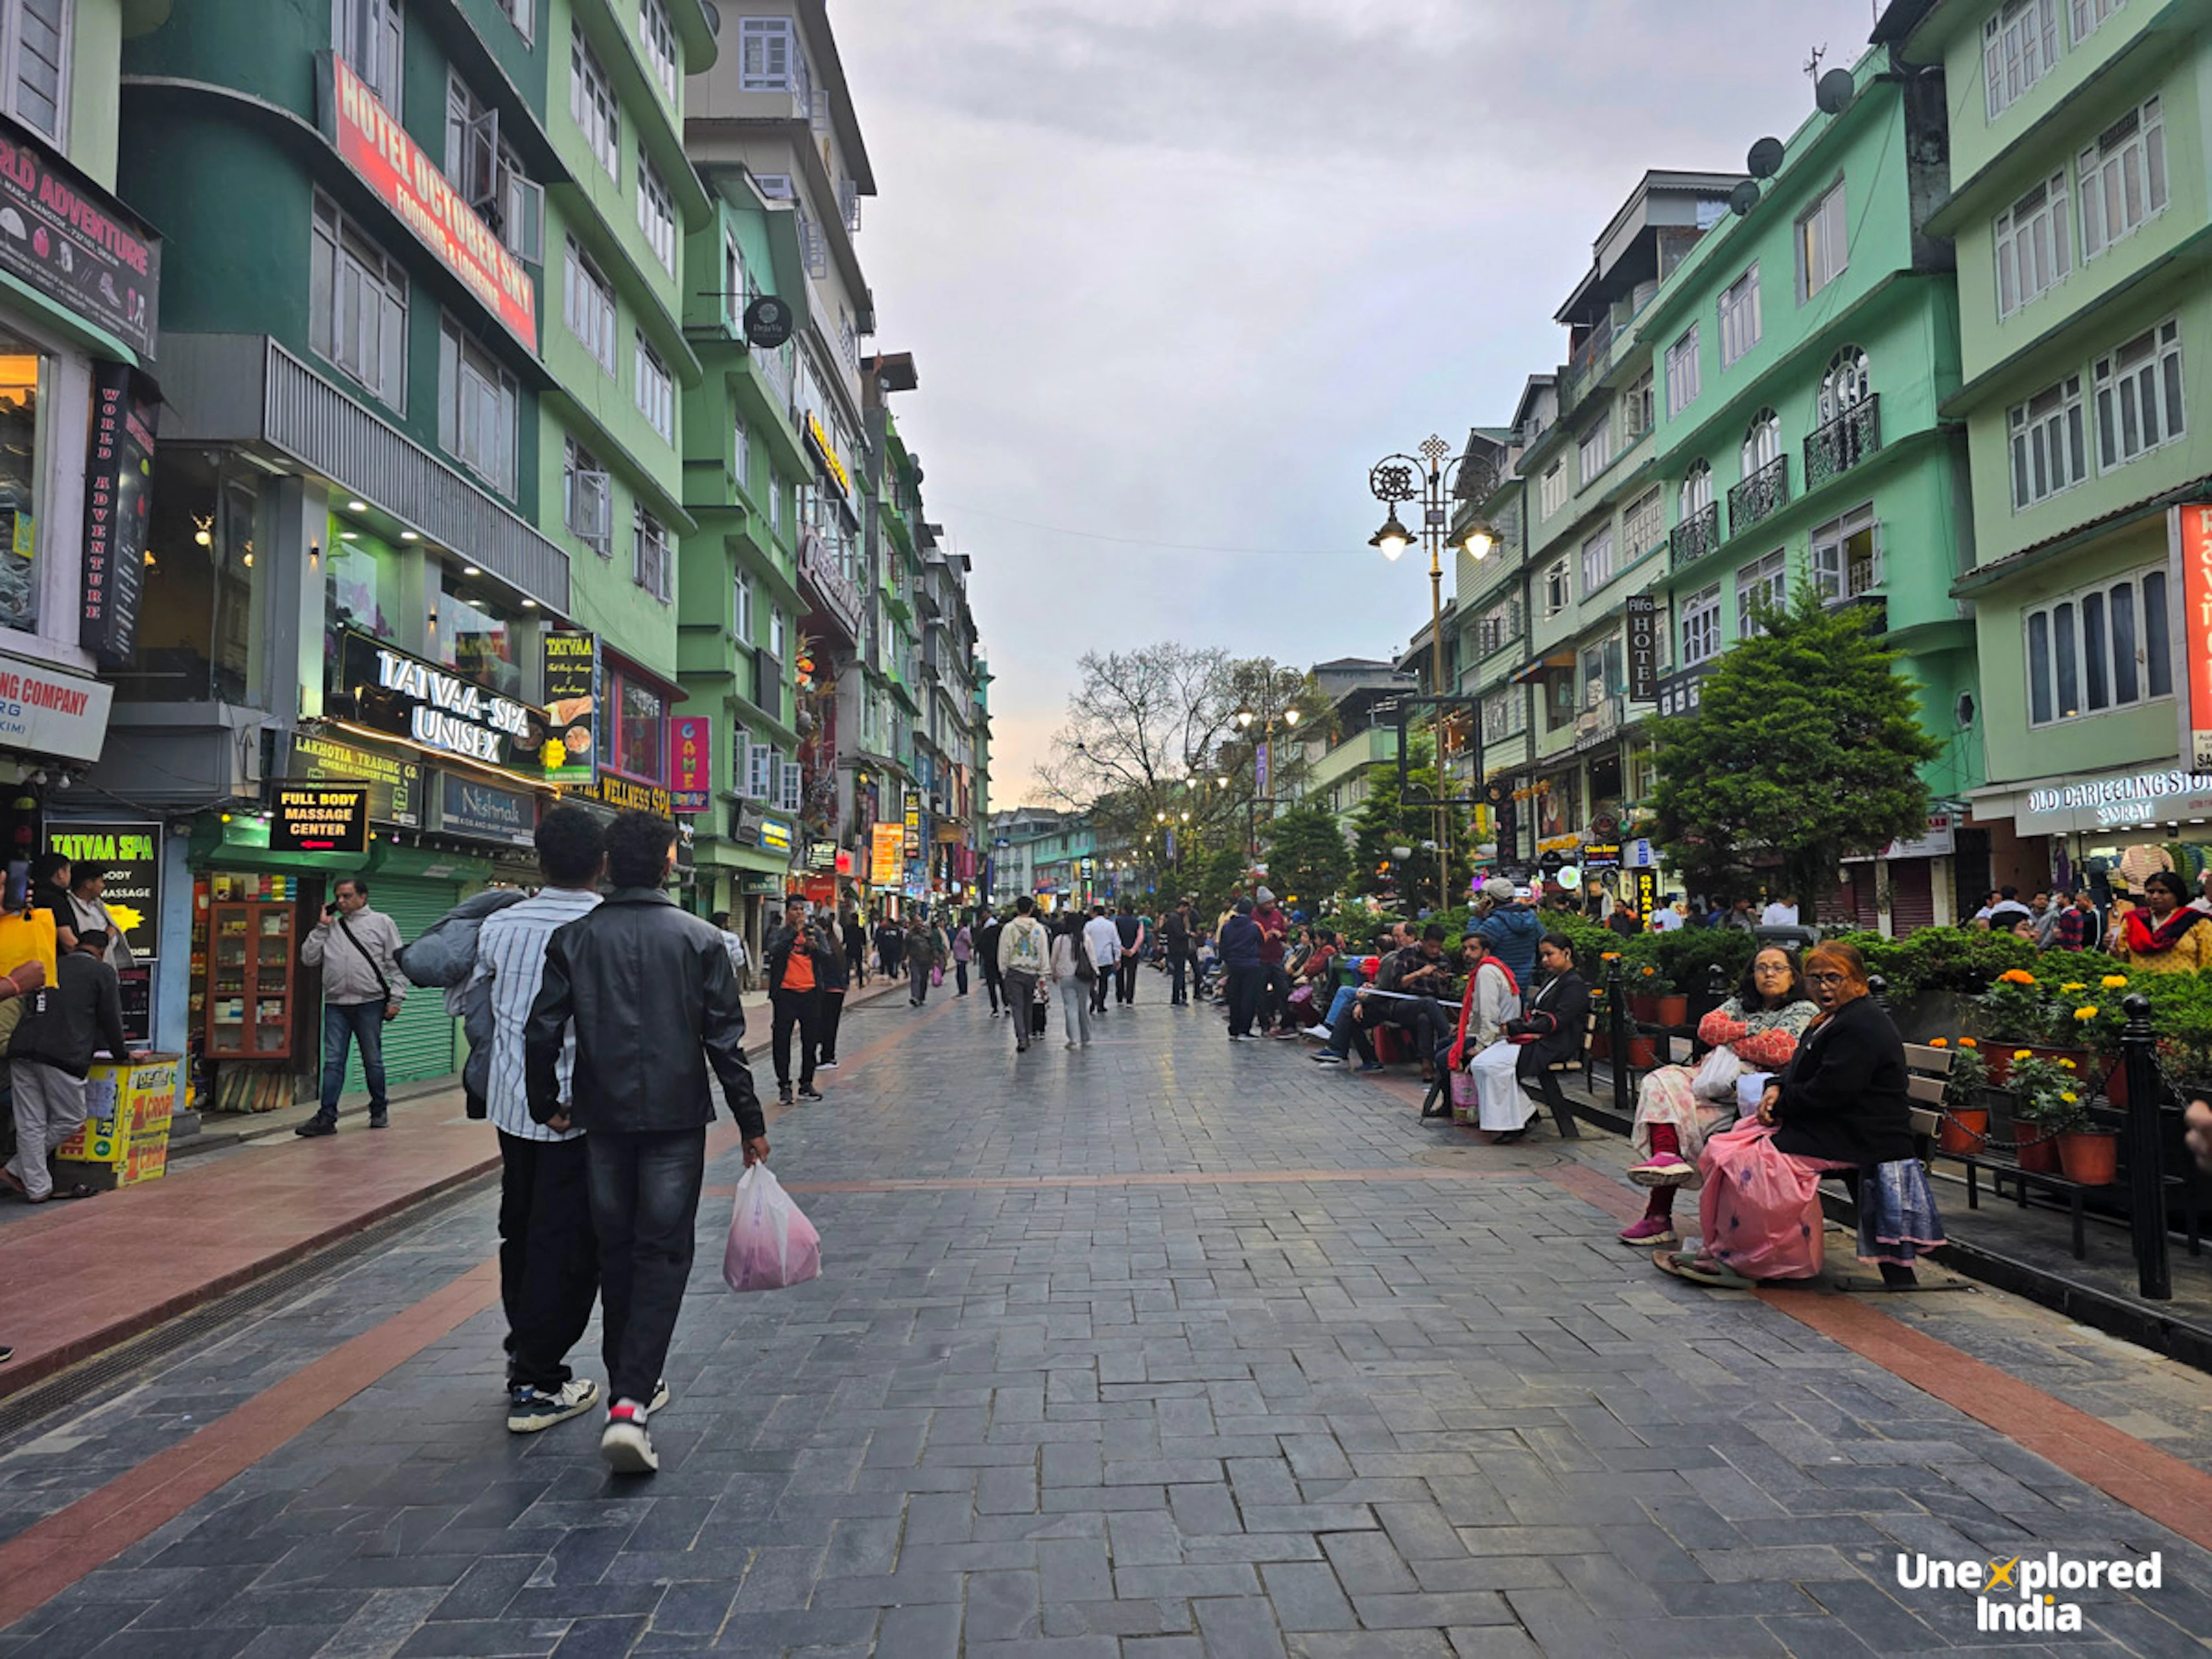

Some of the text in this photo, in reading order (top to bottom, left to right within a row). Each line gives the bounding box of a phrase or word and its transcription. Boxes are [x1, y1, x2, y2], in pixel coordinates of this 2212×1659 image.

[341, 59, 530, 315] HOTEL OCTOBER SKY
[39, 174, 148, 278] ADVENTURE
[86, 388, 120, 619] WORLD ADVENTURE
[546, 637, 593, 656] TATVAA
[1628, 598, 1653, 697] Alfa HOTEL
[21, 677, 89, 717] COMPANY
[411, 704, 502, 764] UNISEX
[295, 736, 352, 764] LAKHOTIA
[357, 751, 402, 775] TRADING
[680, 722, 696, 789] GAME
[281, 792, 359, 806] FULL BODY
[603, 777, 650, 811] WELLNESS
[651, 788, 671, 820] SPA
[2027, 789, 2059, 812] OLD
[2062, 772, 2164, 808] DARJEELING
[285, 808, 353, 821] MASSAGE
[289, 823, 346, 836] CENTER
[2095, 801, 2156, 824] SAMRAT
[50, 834, 154, 860] TATVAA SPA
[131, 1095, 146, 1130] 1
